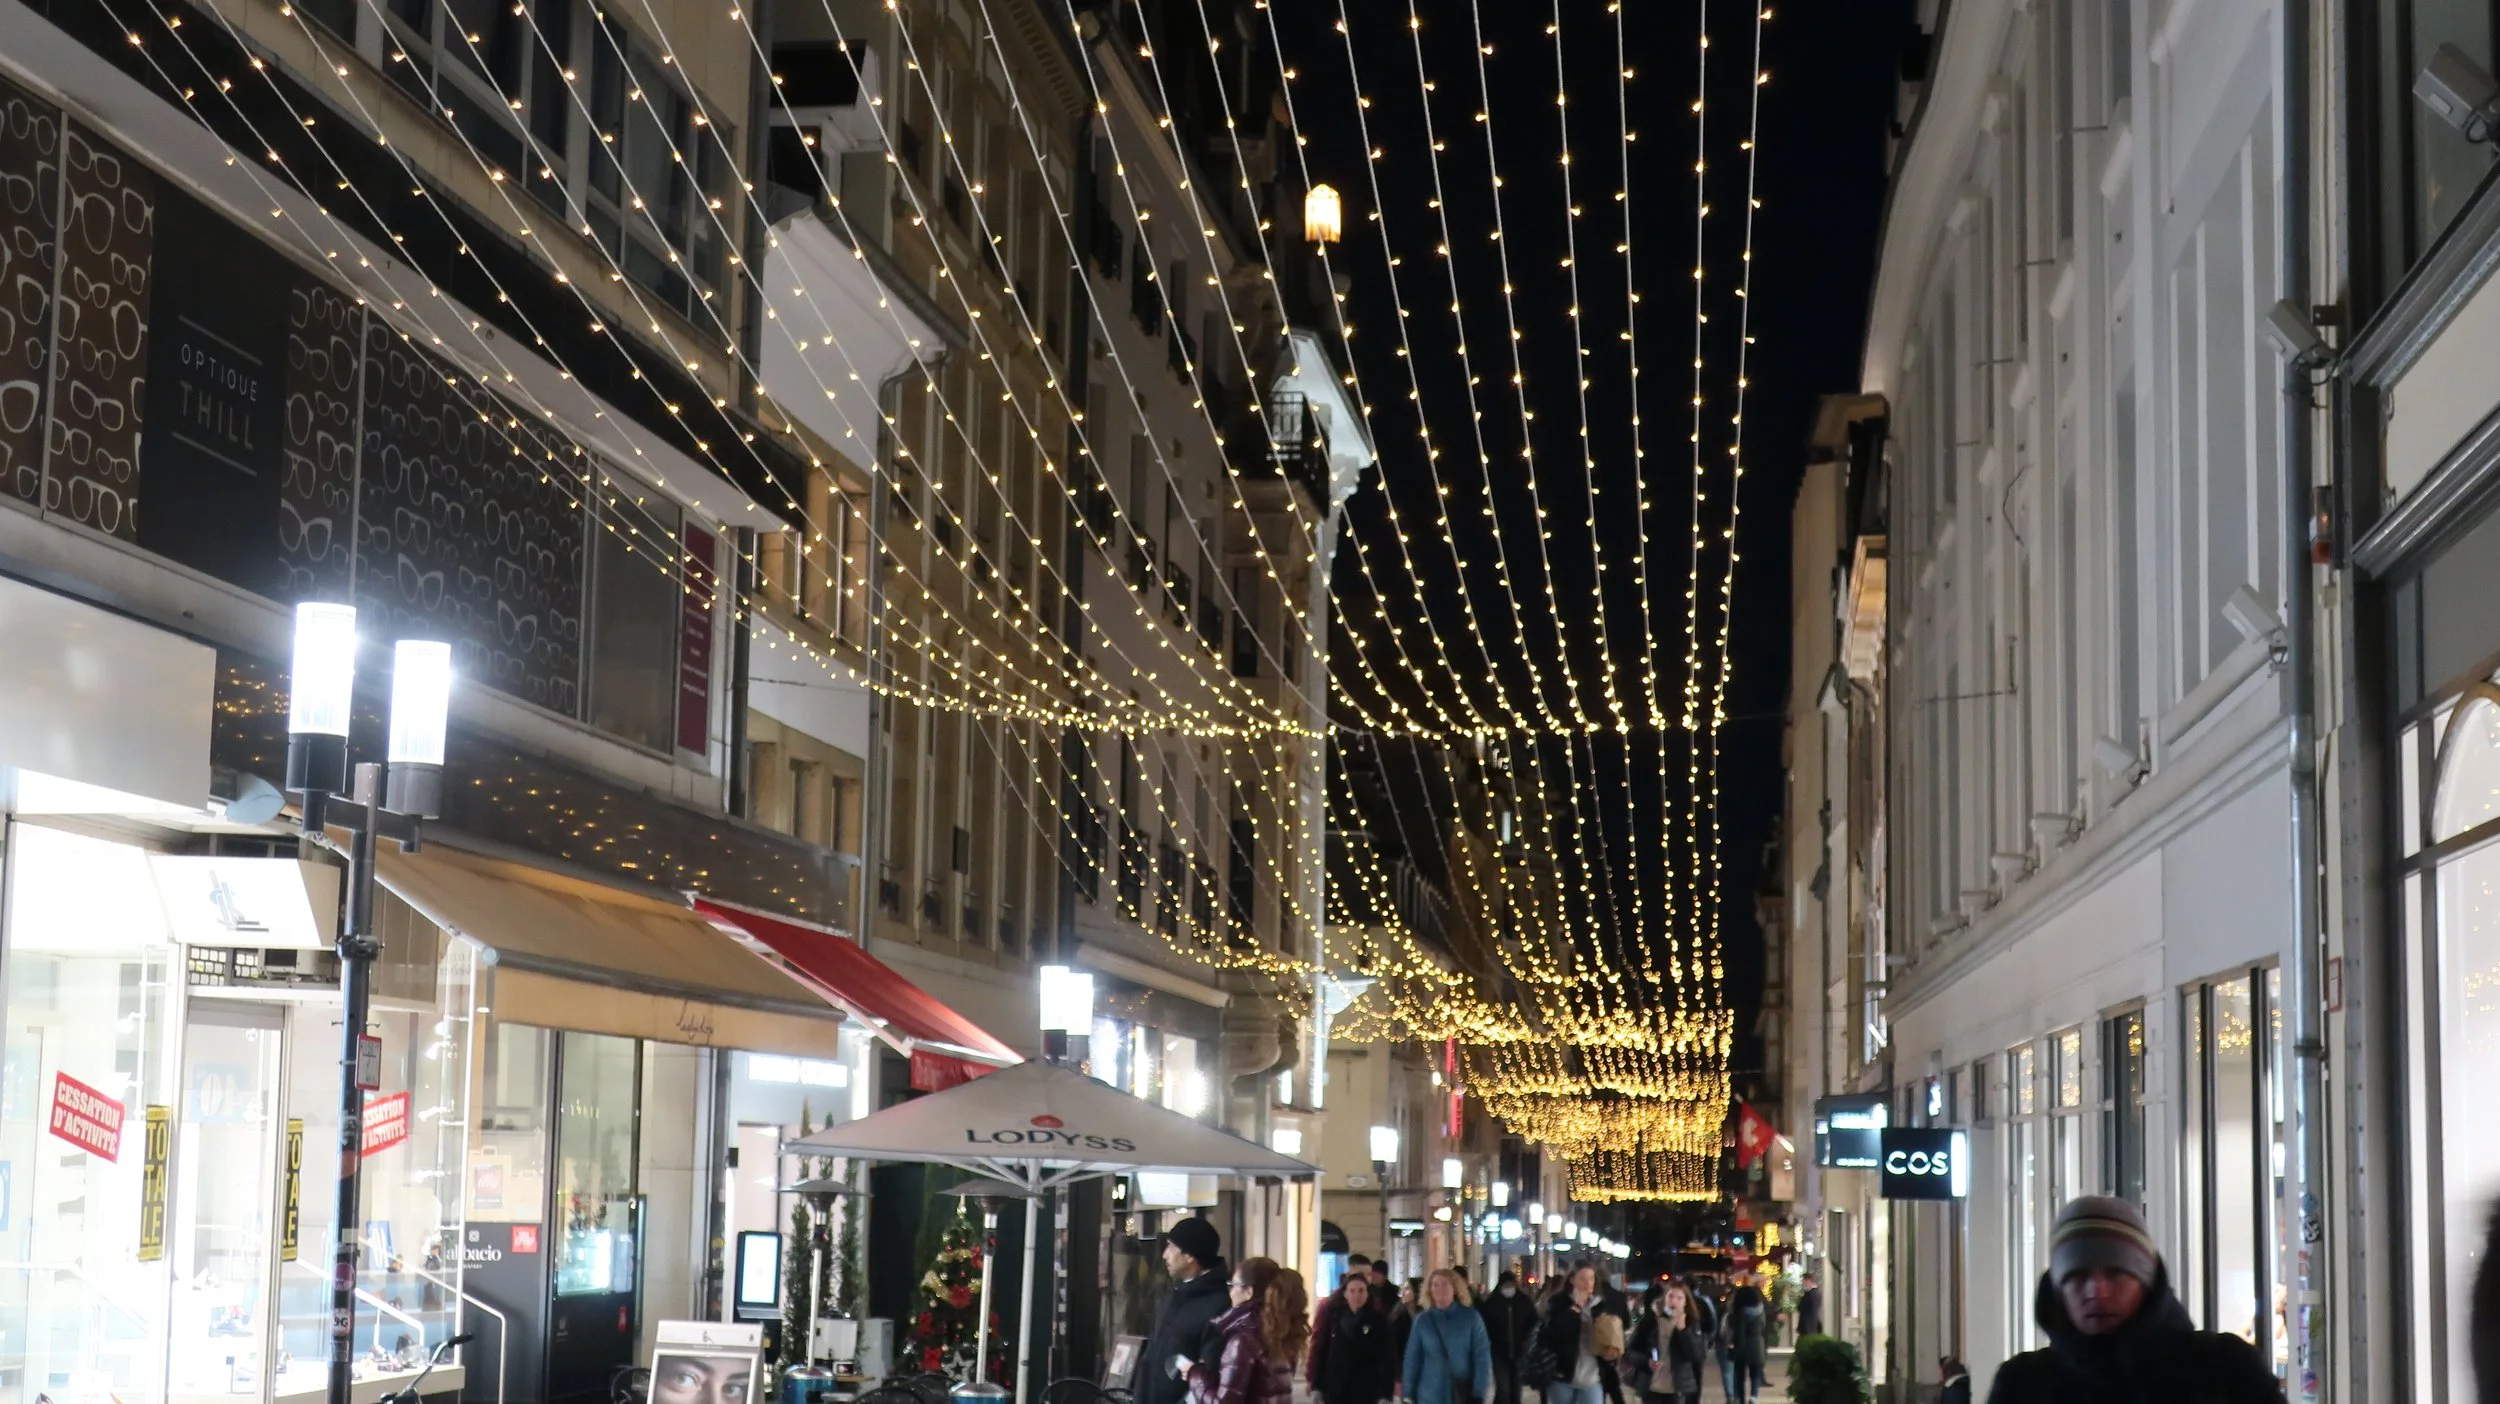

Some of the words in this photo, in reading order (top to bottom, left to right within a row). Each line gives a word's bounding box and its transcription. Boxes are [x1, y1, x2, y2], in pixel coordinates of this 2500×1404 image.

[181, 343, 257, 402] OPTIQUE
[180, 380, 254, 450] THILL
[53, 1105, 118, 1155] D'ACTIVITÉ
[57, 1081, 121, 1131] CESSATION
[966, 1129, 1137, 1152] LODYSS
[1885, 1150, 1949, 1176] COS
